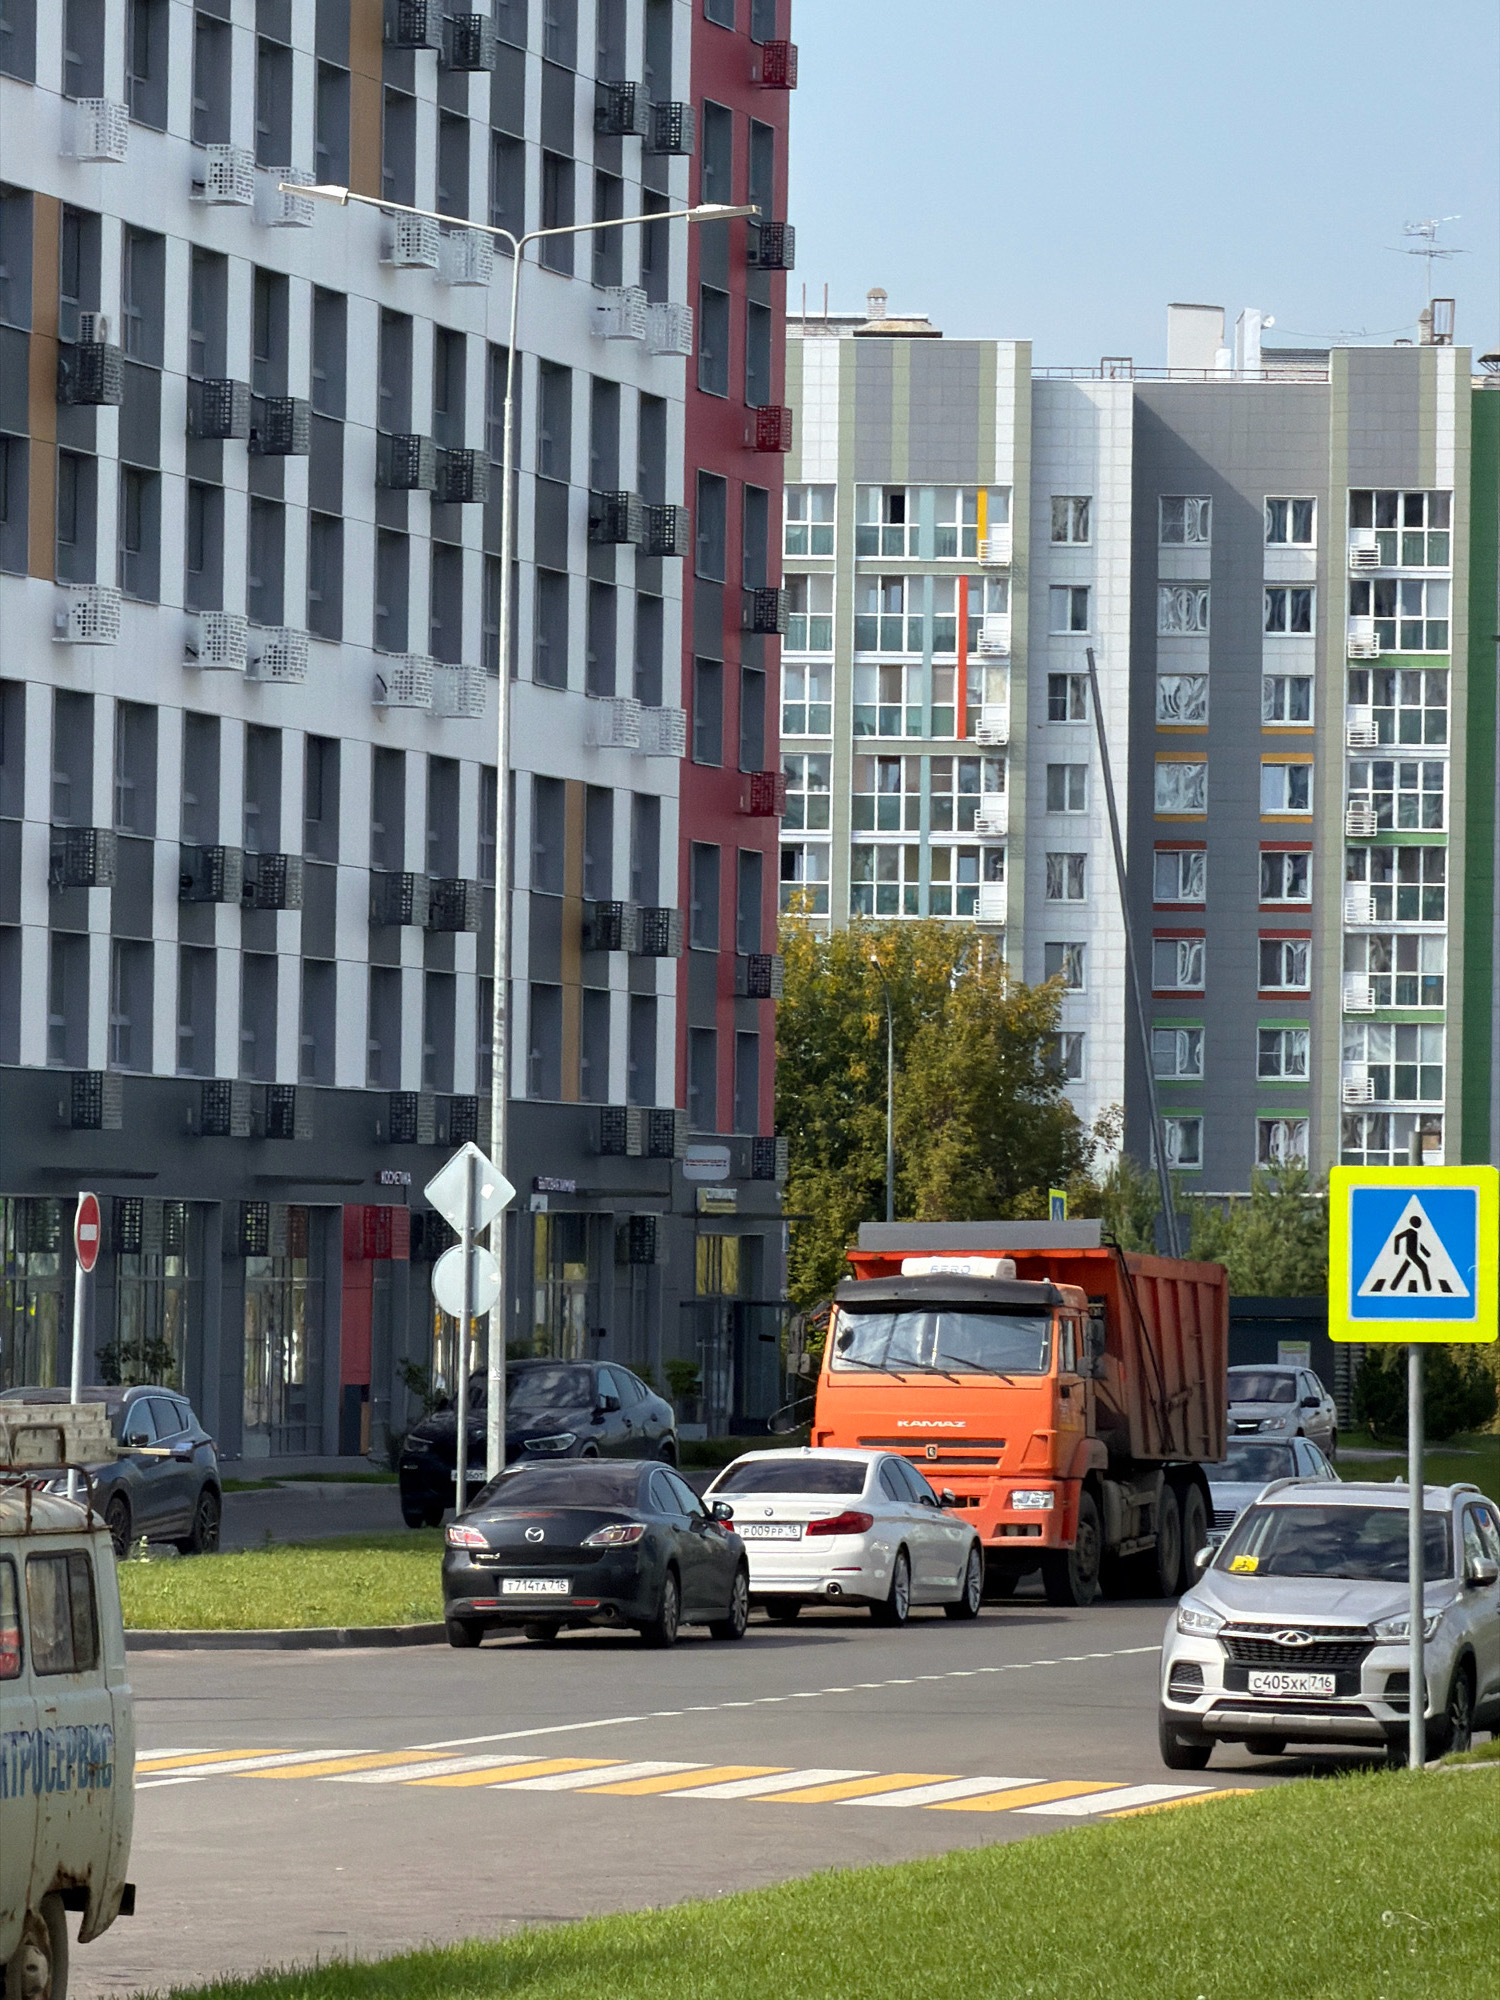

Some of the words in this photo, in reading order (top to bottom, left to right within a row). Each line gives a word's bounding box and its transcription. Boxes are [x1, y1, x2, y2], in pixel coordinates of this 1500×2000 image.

[897, 1420, 966, 1428] KAMAZ
[1253, 1675, 1308, 1691] С405ХК
[1310, 1676, 1332, 1688] 716
